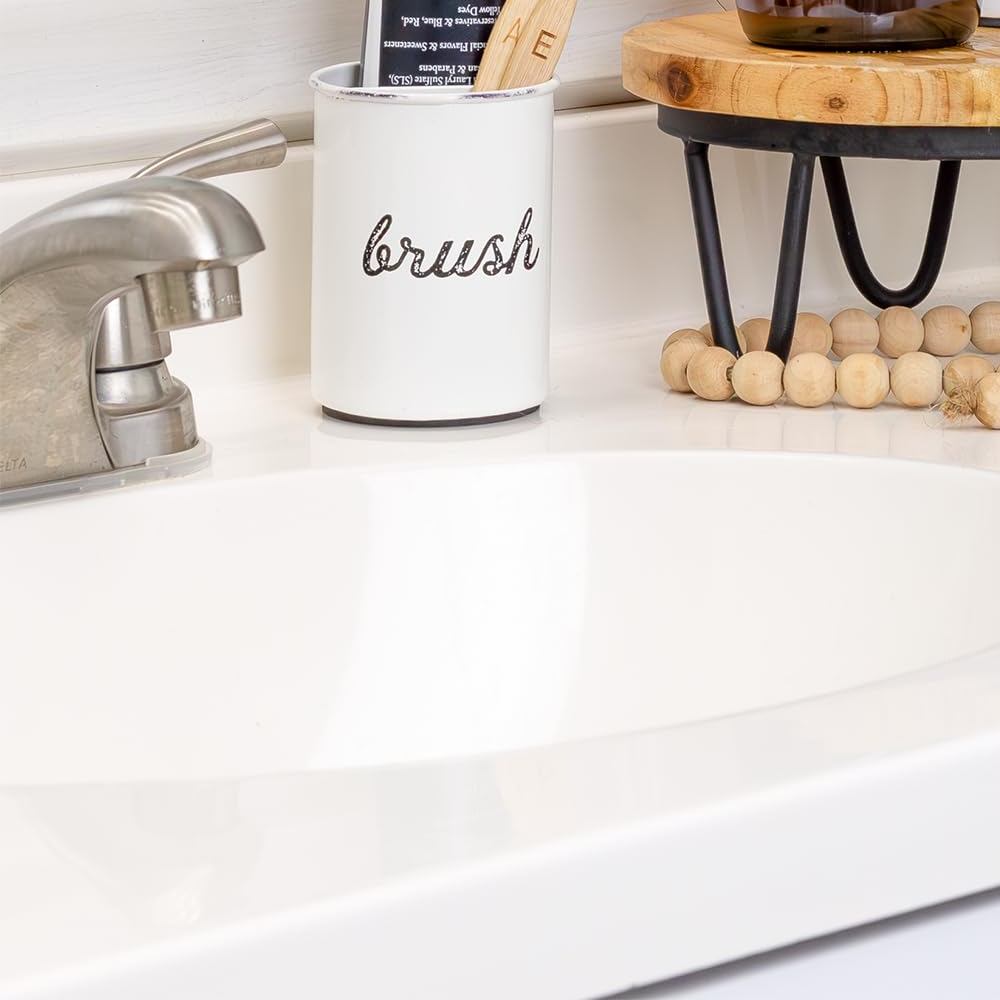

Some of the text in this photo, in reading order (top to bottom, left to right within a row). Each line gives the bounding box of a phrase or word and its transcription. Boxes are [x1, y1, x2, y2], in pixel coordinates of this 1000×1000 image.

[458, 4, 478, 16] Dyes
[401, 16, 420, 26] Red,
[422, 16, 442, 26] Blue,
[445, 18, 453, 26] &
[384, 41, 427, 50] Sweeteners
[429, 42, 438, 51] &
[440, 42, 468, 51] Flavors
[531, 29, 557, 60] E
[419, 65, 456, 74] Parabens
[458, 65, 466, 74] &
[388, 74, 413, 85] (SLS),
[415, 76, 443, 85] Sulfate
[445, 75, 471, 85] Lauryl
[362, 207, 540, 279] brush
